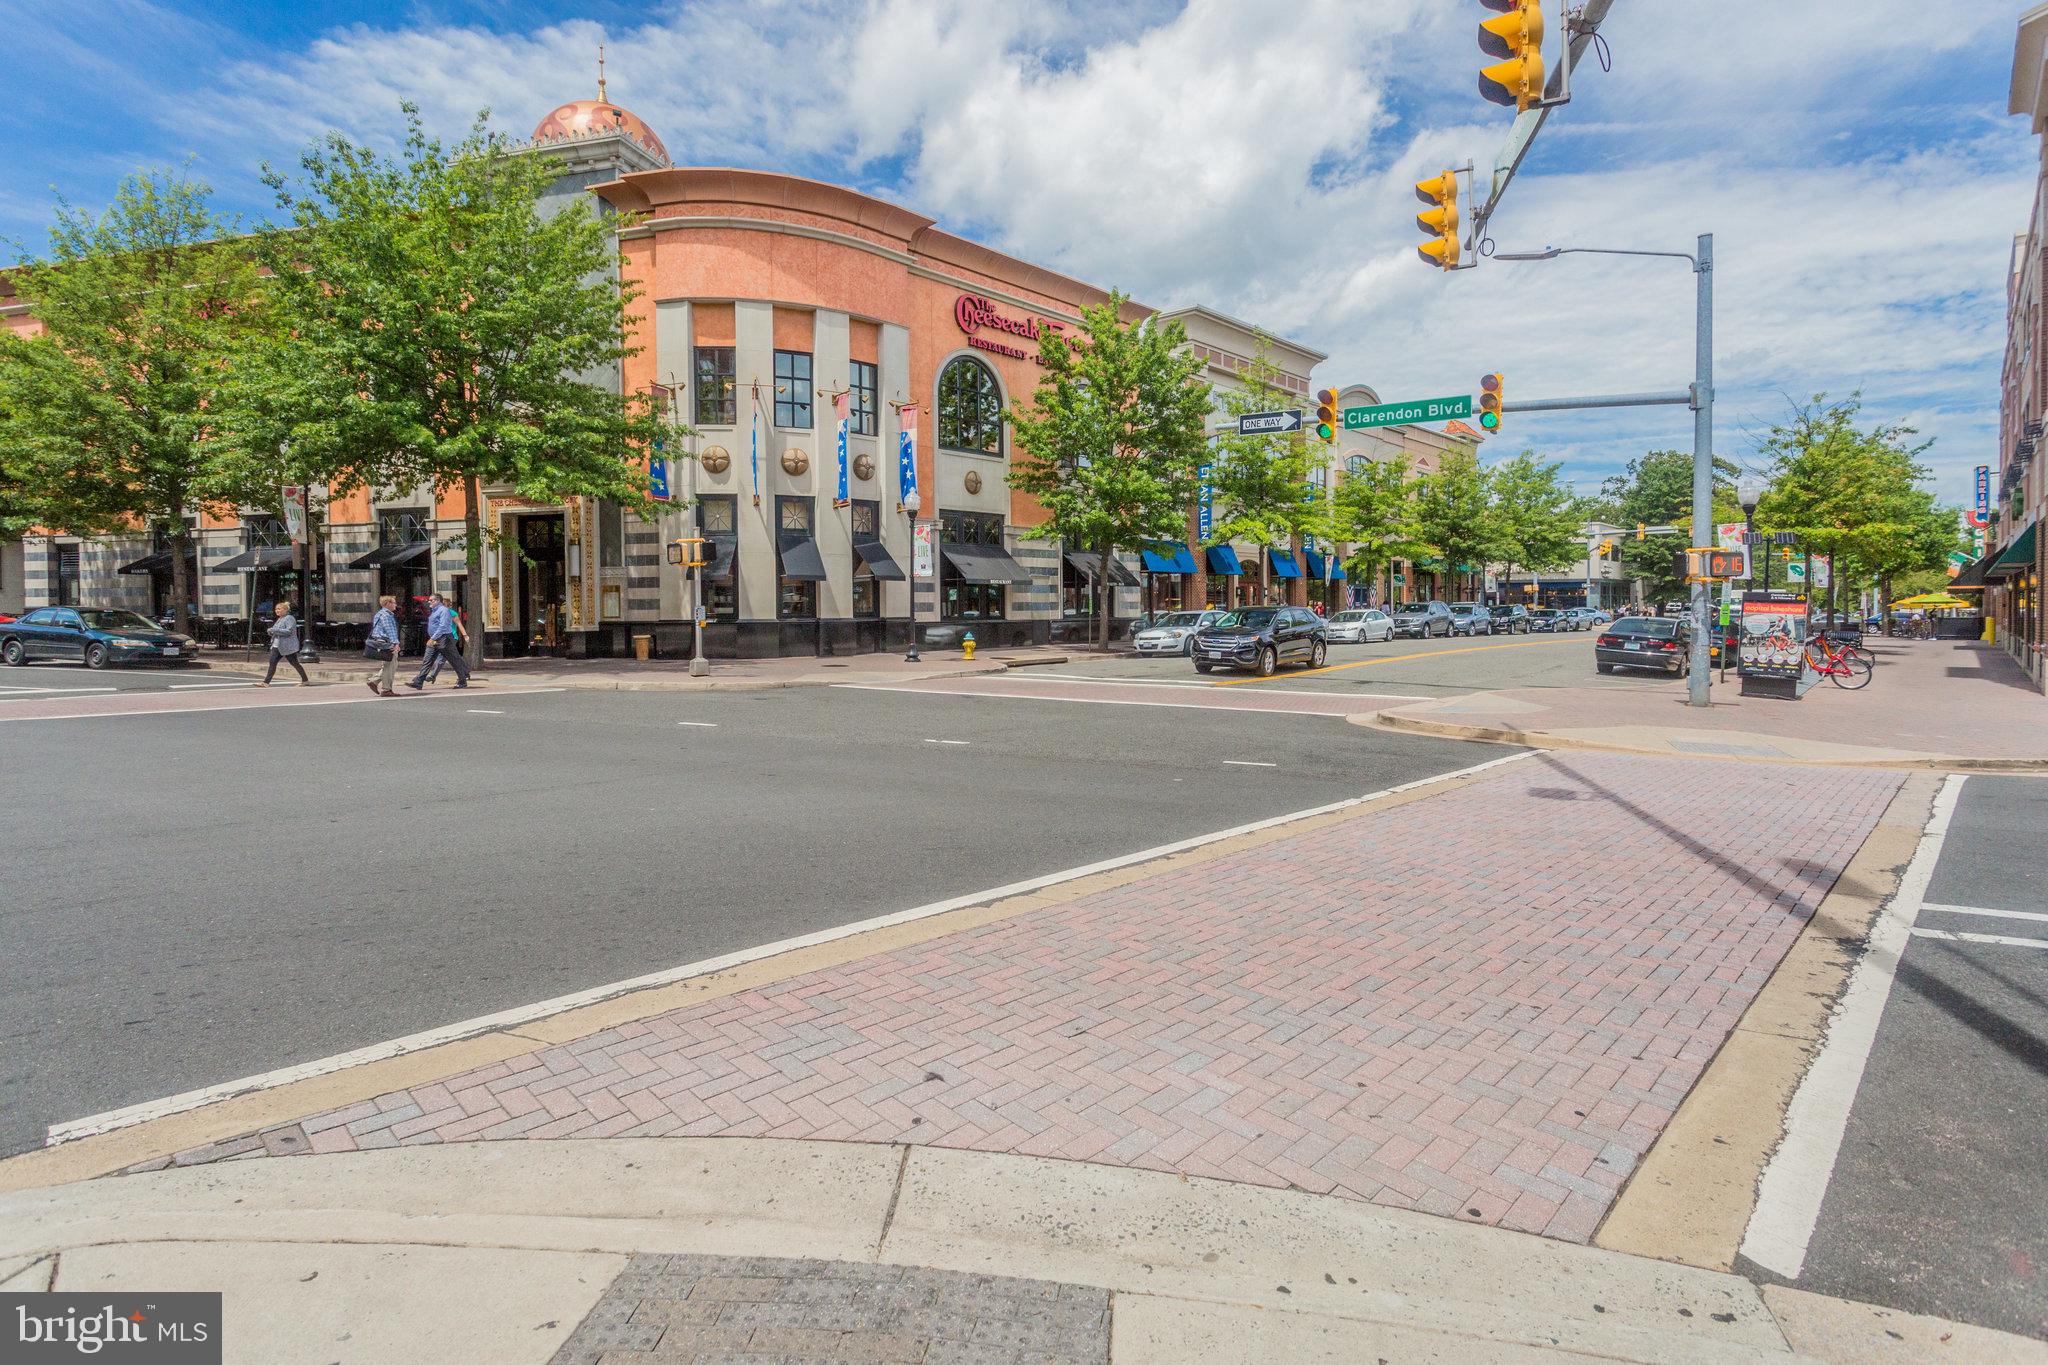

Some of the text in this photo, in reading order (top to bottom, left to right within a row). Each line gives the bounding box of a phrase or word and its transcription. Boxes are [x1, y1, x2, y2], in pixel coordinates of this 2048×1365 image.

[978, 297, 997, 313] The
[955, 294, 1041, 340] Cheesecak
[968, 336, 1028, 361] RESTAURANT
[1245, 417, 1281, 429] ONE WAY
[1348, 402, 1468, 425] Clarendon Blvd.
[1978, 467, 1987, 514] PARKING
[1200, 506, 1209, 540] ALLEN
[917, 545, 929, 557] LIVE
[1731, 556, 1743, 572] 16
[1745, 604, 1805, 613] capital bikeshare
